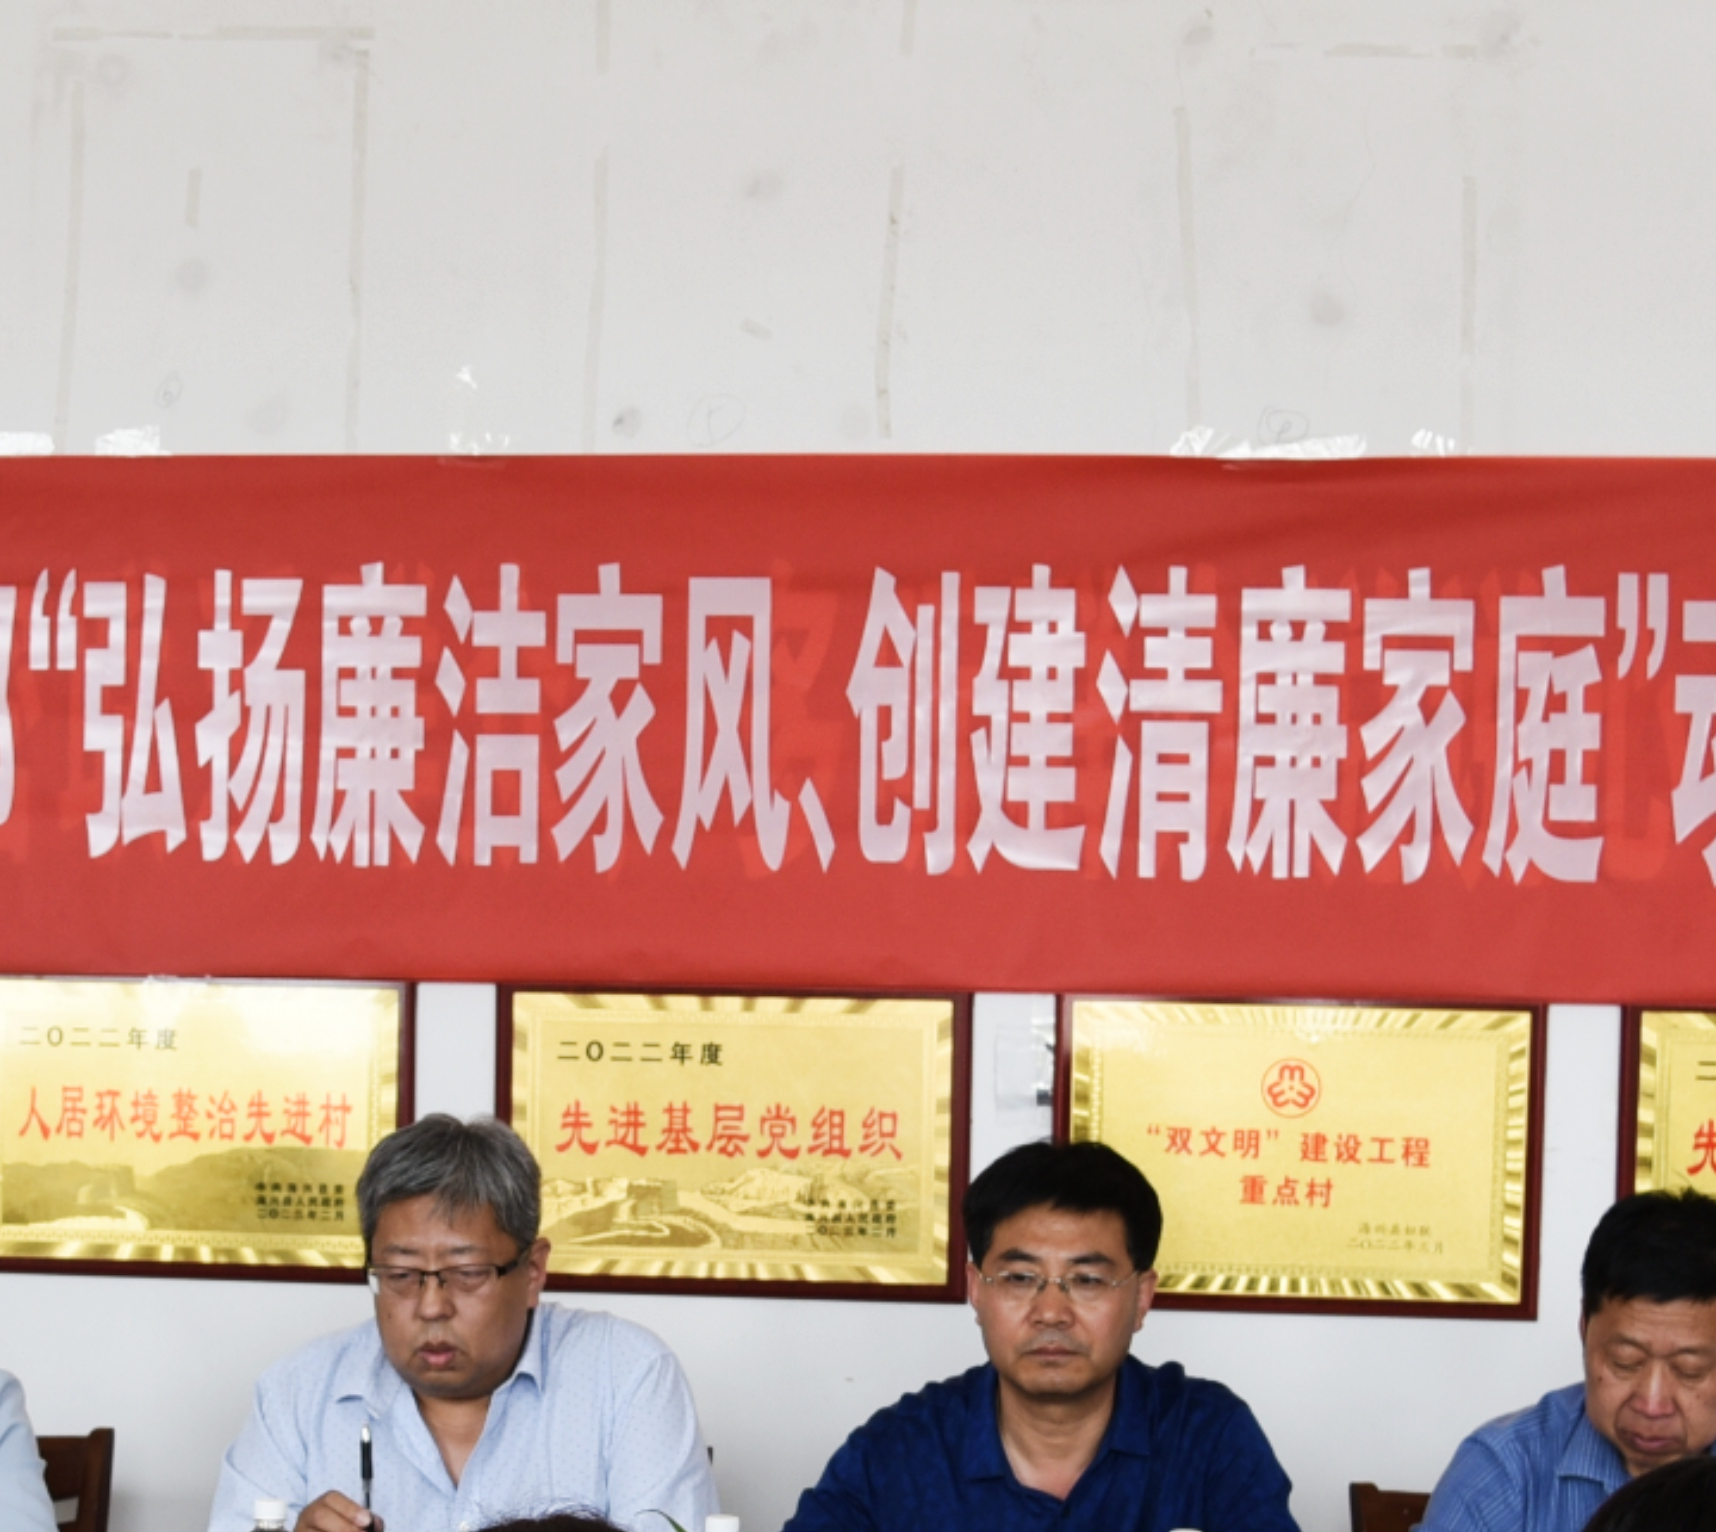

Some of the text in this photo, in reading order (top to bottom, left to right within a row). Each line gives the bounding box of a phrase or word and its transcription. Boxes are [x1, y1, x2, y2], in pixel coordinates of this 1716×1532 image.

[18, 1085, 354, 1148] 人居环境整治先进村
[555, 1098, 904, 1160] 先进基层党组织
[1239, 1174, 1335, 1208] 重点村
